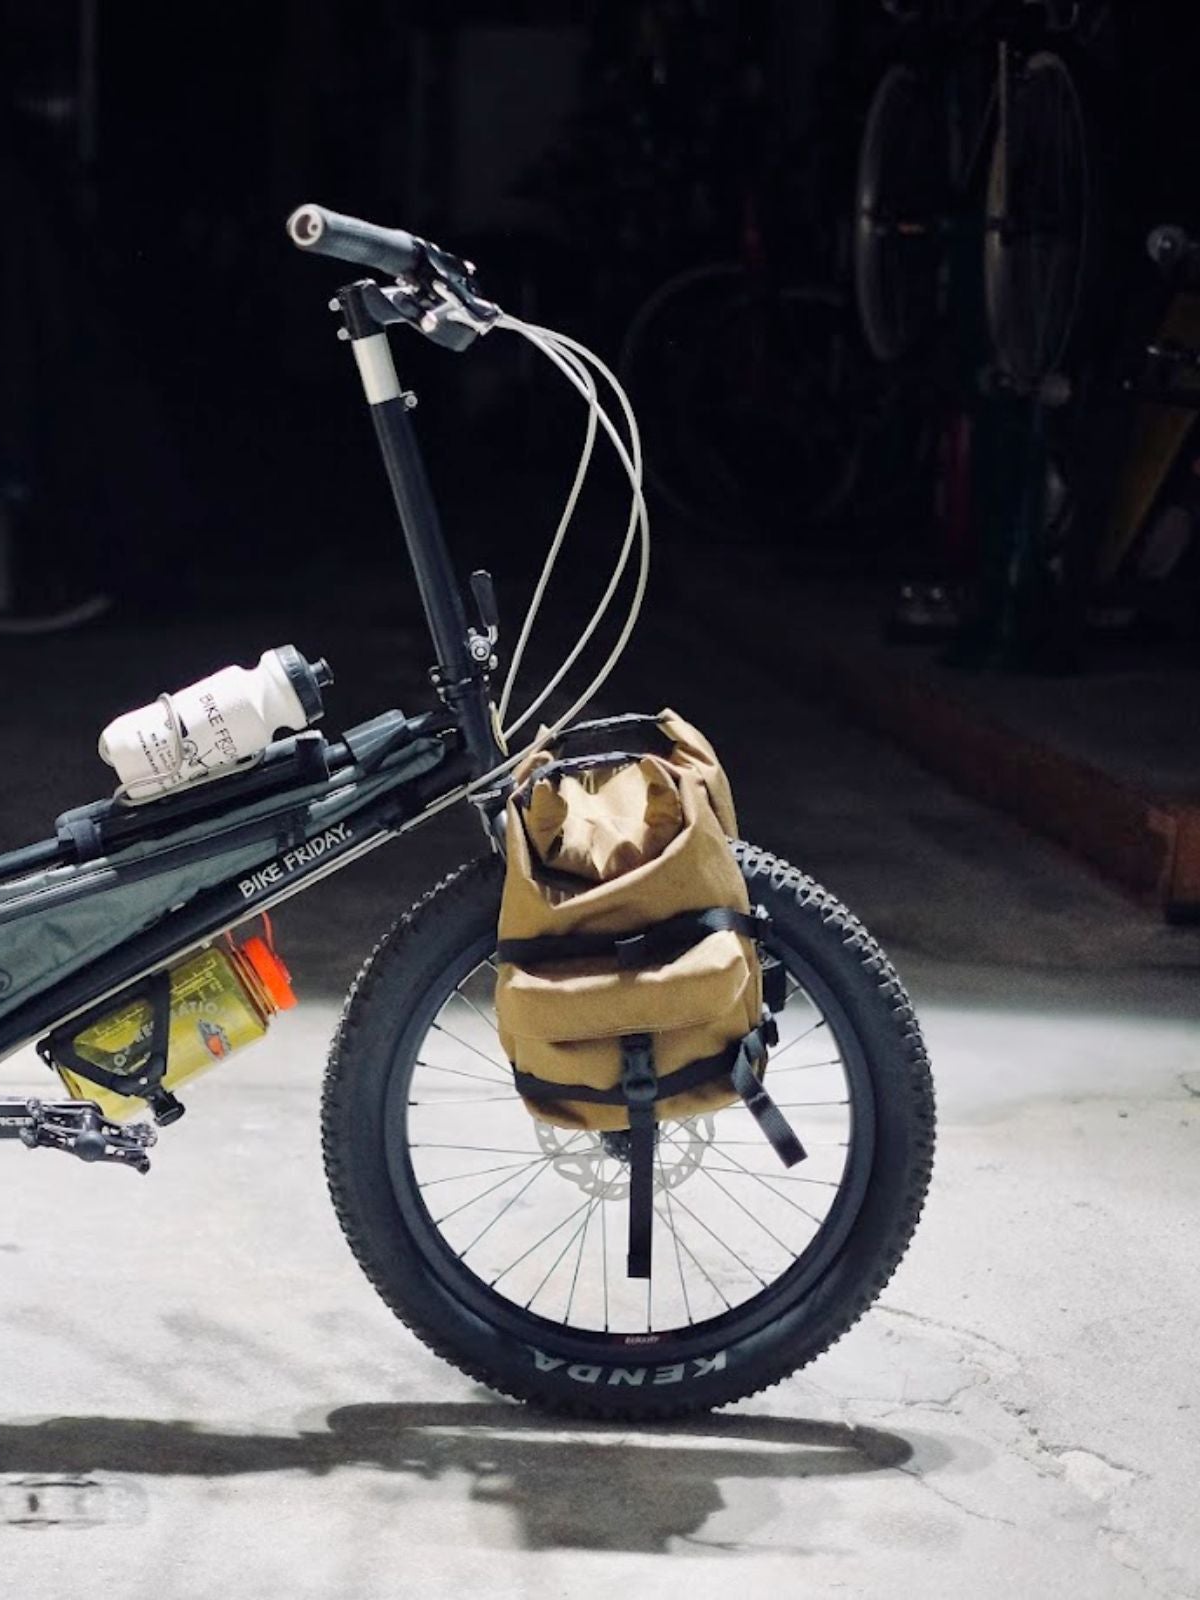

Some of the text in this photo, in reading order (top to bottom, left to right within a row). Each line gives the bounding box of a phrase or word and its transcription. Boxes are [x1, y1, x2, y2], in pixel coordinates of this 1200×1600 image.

[199, 692, 225, 728] BIKE
[238, 862, 284, 898] BIKE
[533, 1350, 728, 1386] KENDA
